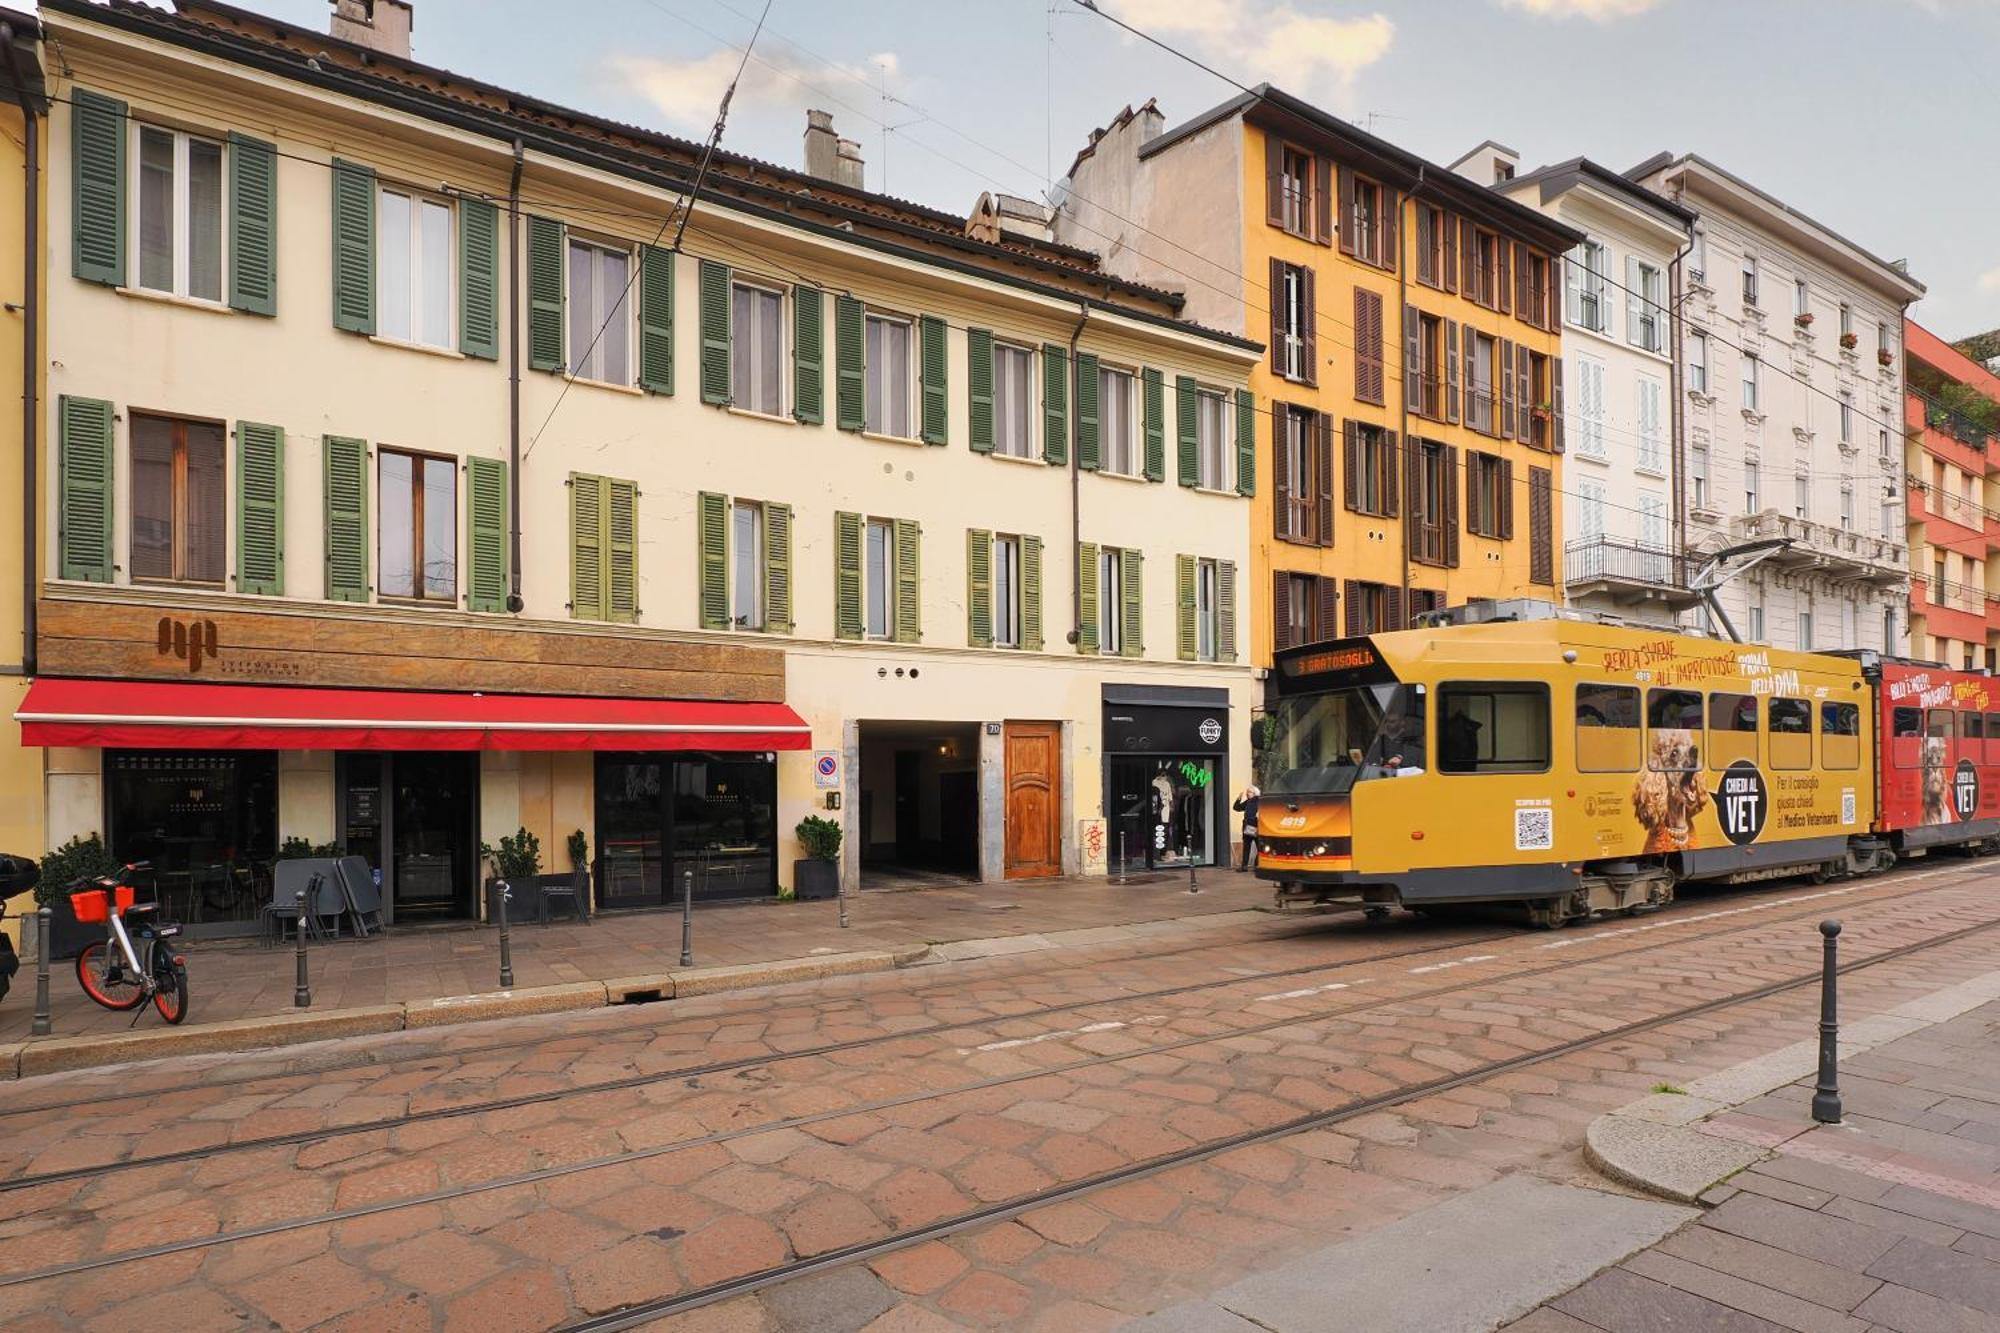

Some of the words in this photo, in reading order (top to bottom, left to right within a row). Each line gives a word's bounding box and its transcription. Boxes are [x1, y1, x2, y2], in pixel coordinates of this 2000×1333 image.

[1774, 670, 1800, 697] DIVA
[1200, 726, 1221, 736] FUNKY
[1726, 778, 1748, 793] CHIEDI
[1749, 777, 1759, 792] AL
[1956, 785, 1975, 812] VET
[1726, 795, 1759, 833] VET
[1784, 813, 1806, 828] Medico
[1806, 811, 1838, 826] Veterinario
